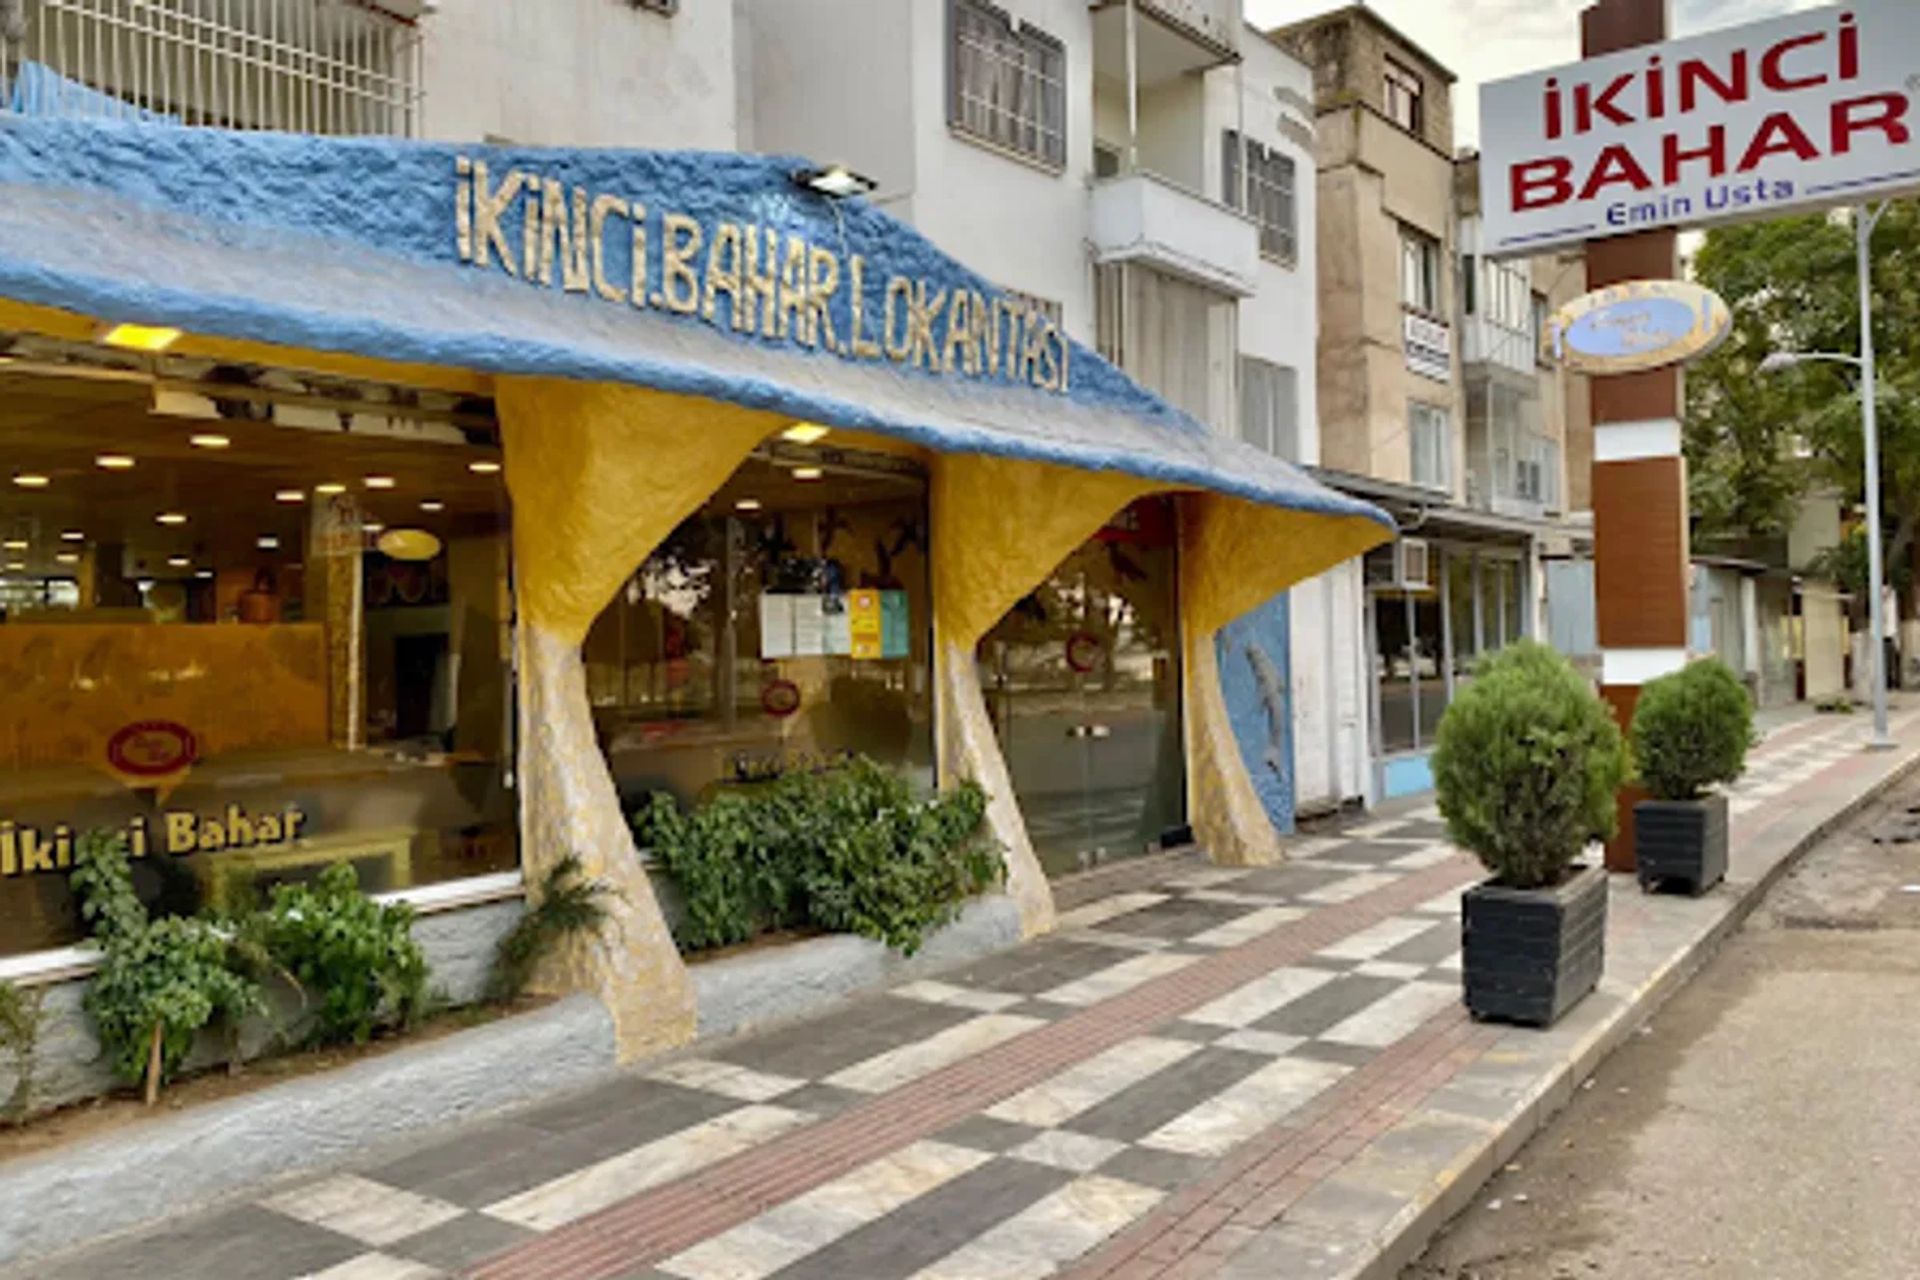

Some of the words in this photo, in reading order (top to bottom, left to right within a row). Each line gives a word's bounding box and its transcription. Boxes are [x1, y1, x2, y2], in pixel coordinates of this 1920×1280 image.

[1543, 12, 1860, 140] İKİNCİ
[1509, 91, 1910, 213] BAHAR
[1606, 193, 1692, 226] Emin
[1704, 178, 1794, 210] Usta
[0, 816, 147, 876] İkii
[165, 804, 304, 854] Bahar
